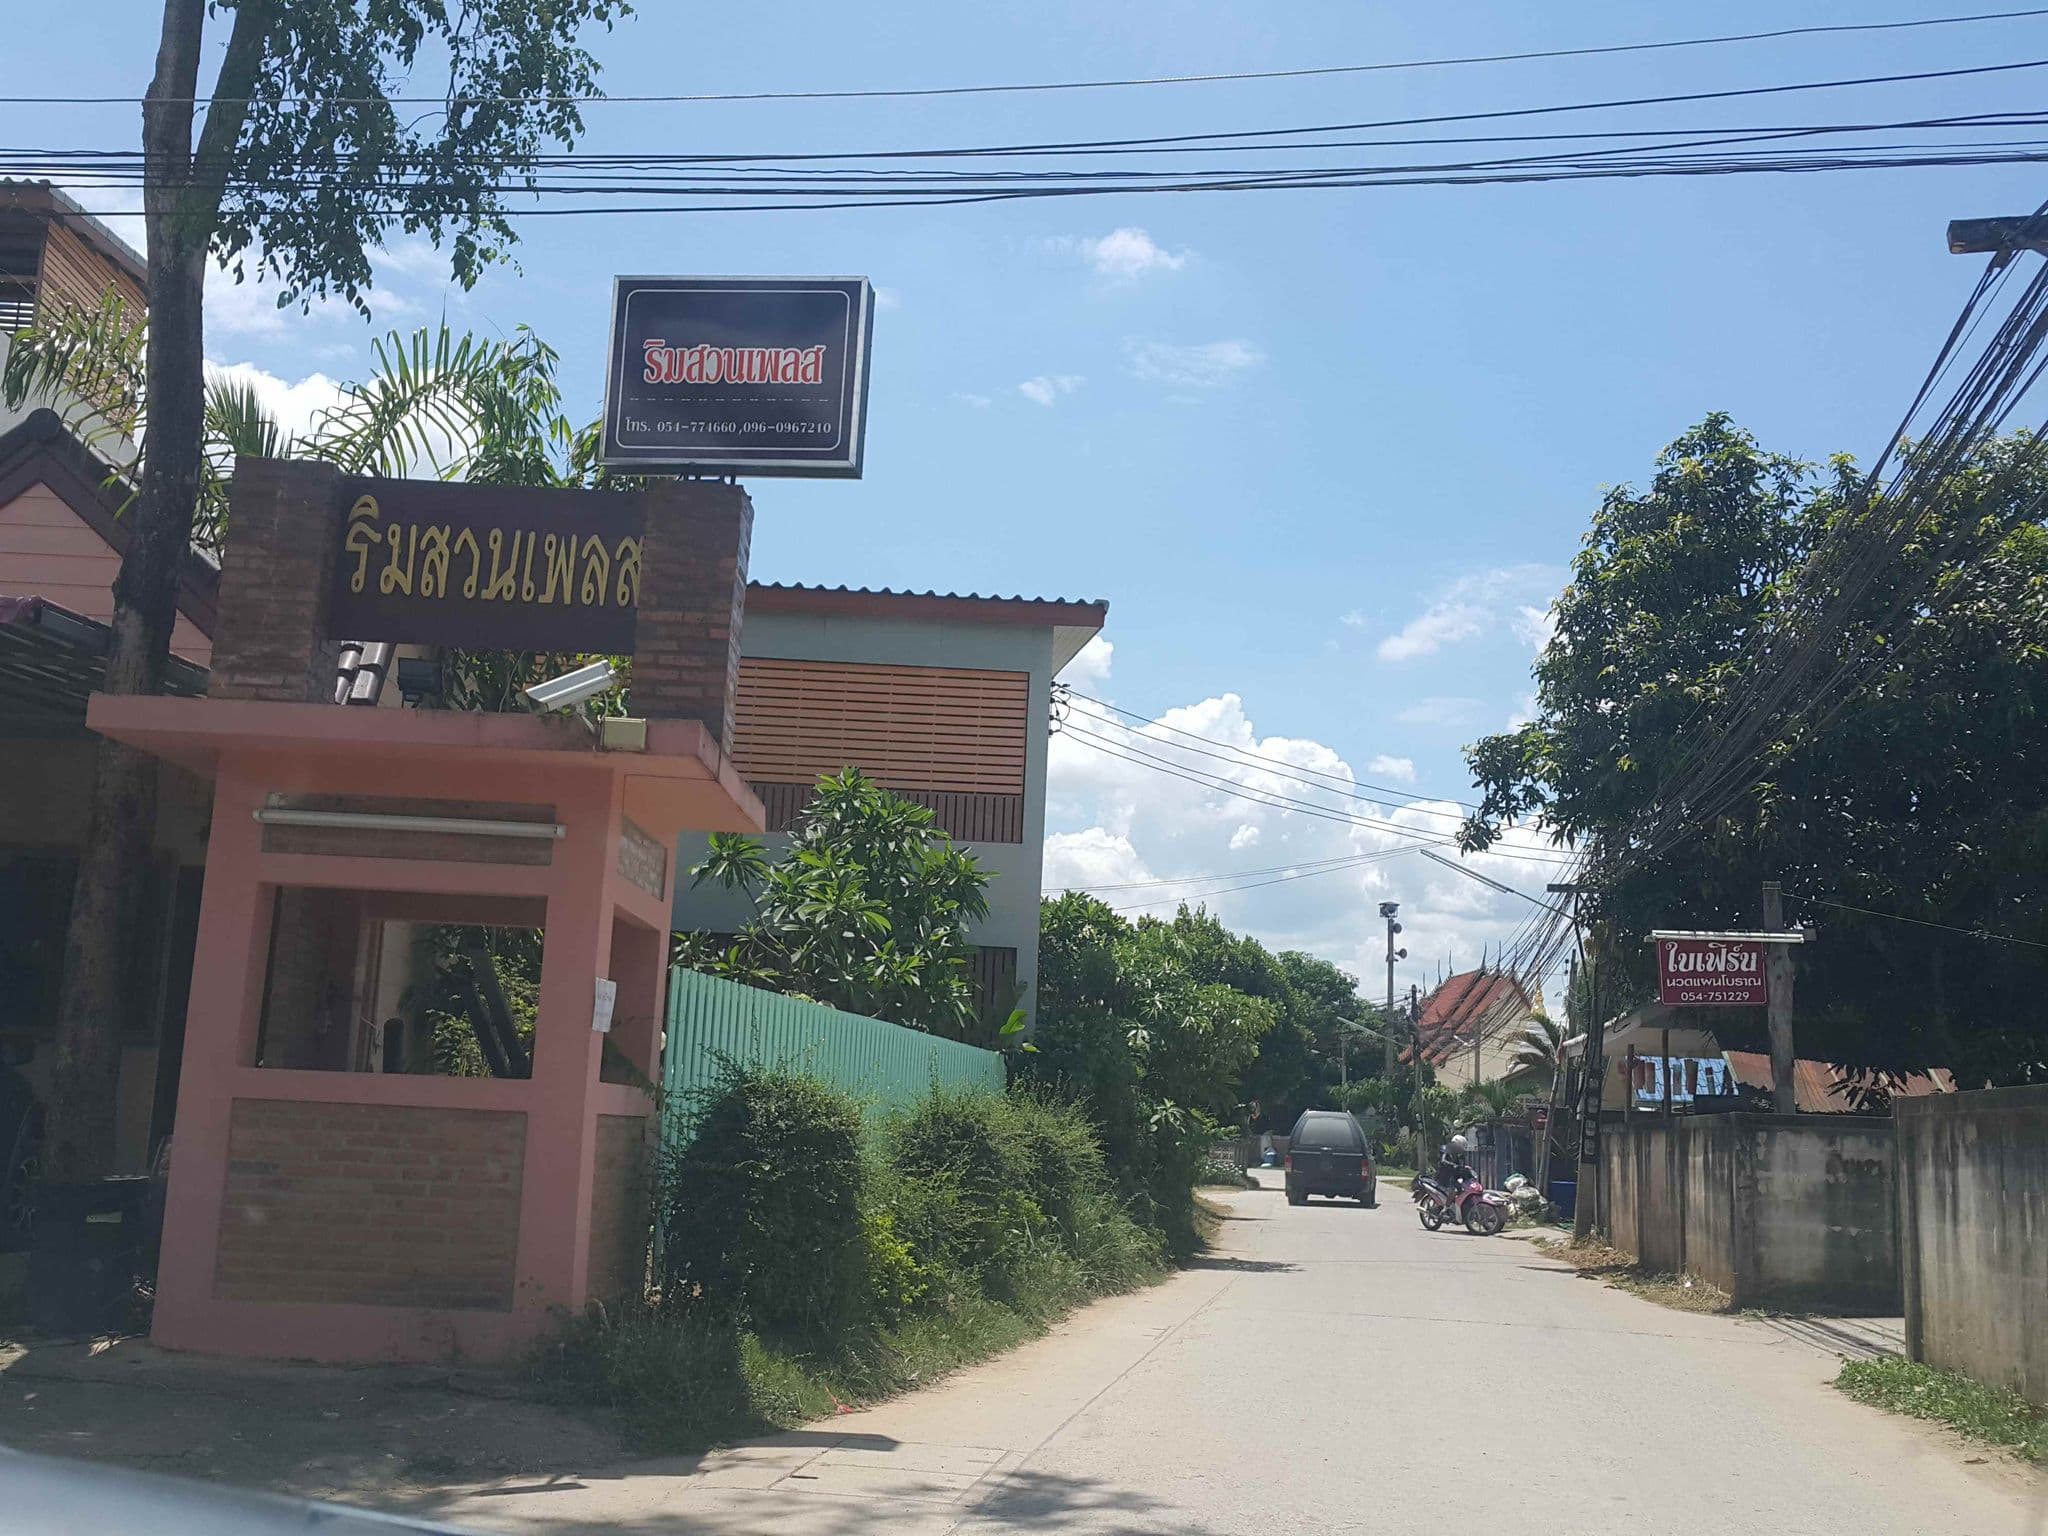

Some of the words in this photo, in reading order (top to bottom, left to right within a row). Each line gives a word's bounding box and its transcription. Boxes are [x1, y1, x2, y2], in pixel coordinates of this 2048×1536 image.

[644, 339, 826, 384] ริมสวนเพลส
[625, 416, 651, 432] โทร.
[345, 494, 643, 606] ริมสวนเพลส
[1666, 942, 1757, 972] ใบเฟิร์น
[1666, 974, 1762, 987] นวดแผนโบราณ
[1681, 991, 1750, 1002] 054-751229
